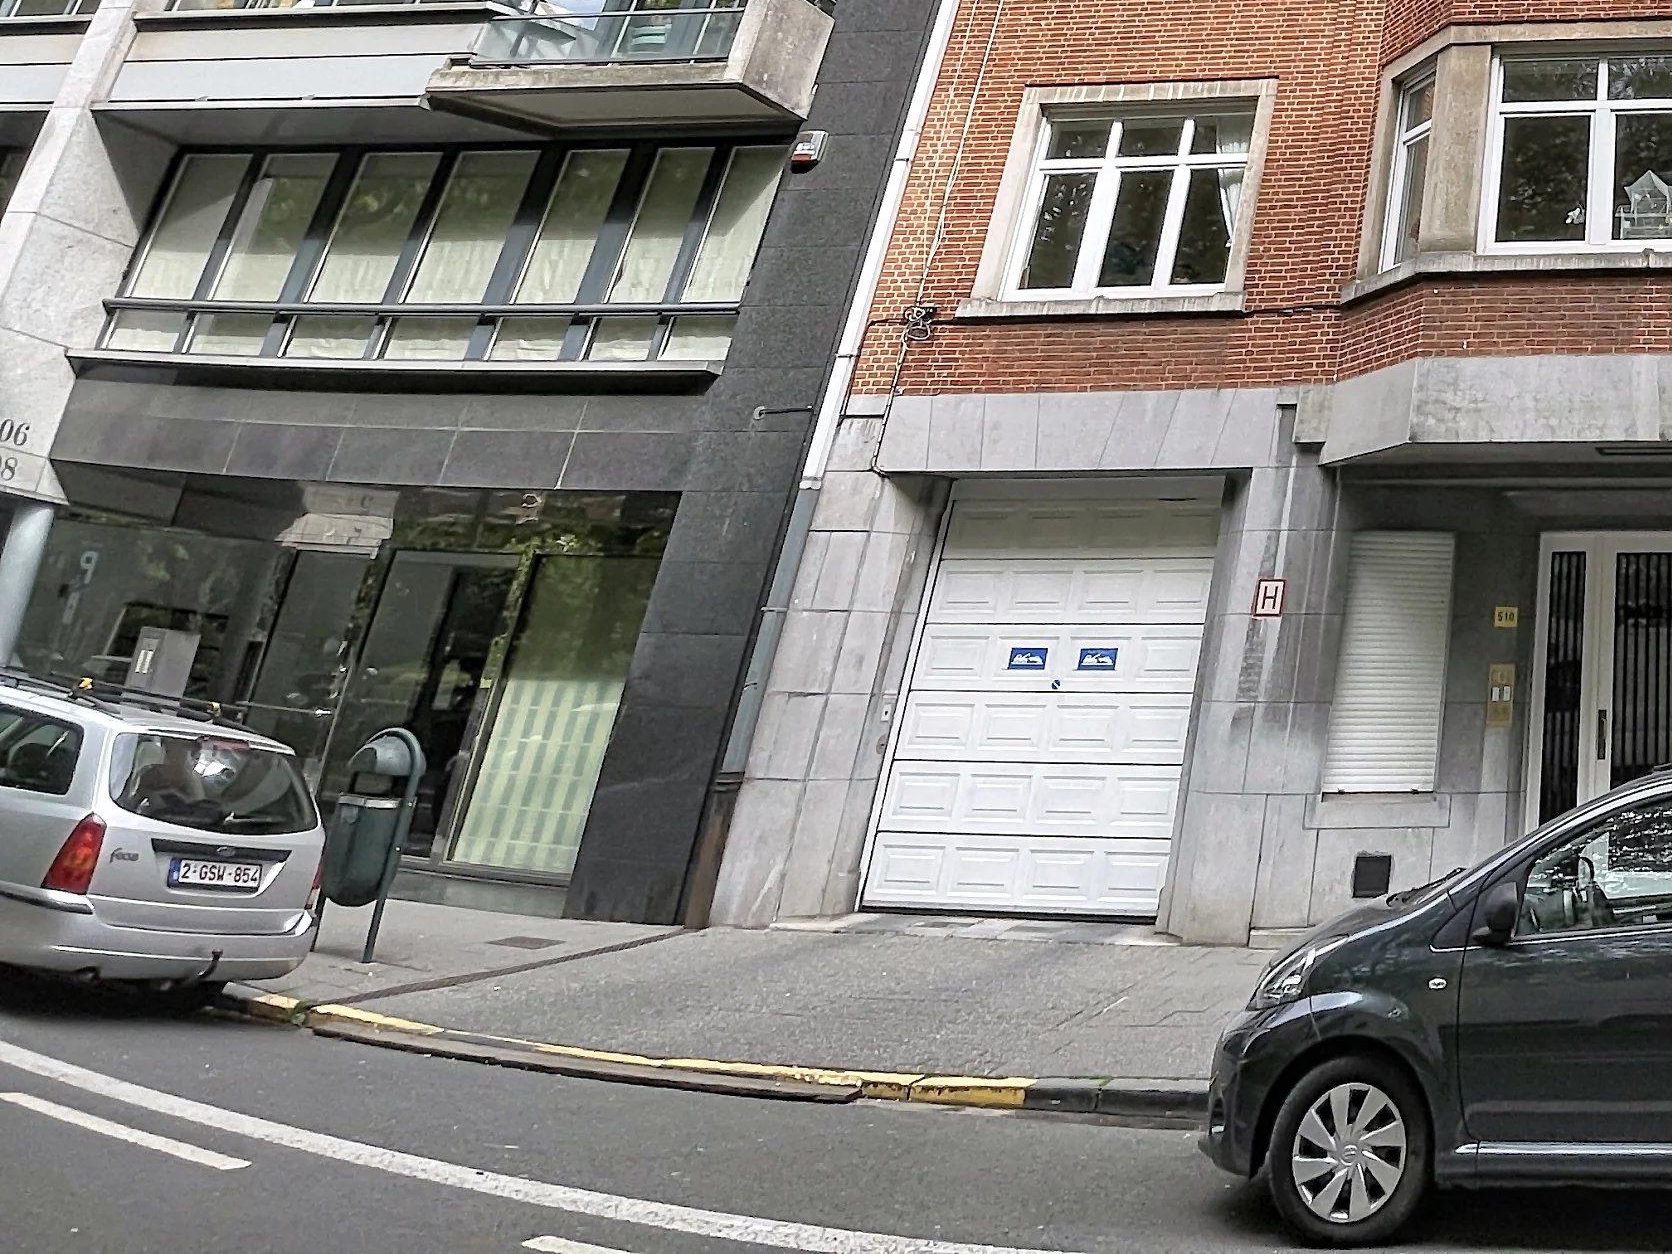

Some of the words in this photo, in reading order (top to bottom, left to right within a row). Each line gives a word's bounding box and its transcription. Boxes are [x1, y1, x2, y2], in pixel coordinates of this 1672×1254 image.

[0, 454, 18, 481] 8
[1261, 586, 1279, 609] H
[1498, 612, 1515, 622] 510
[181, 863, 259, 884] 2-GSW-854
